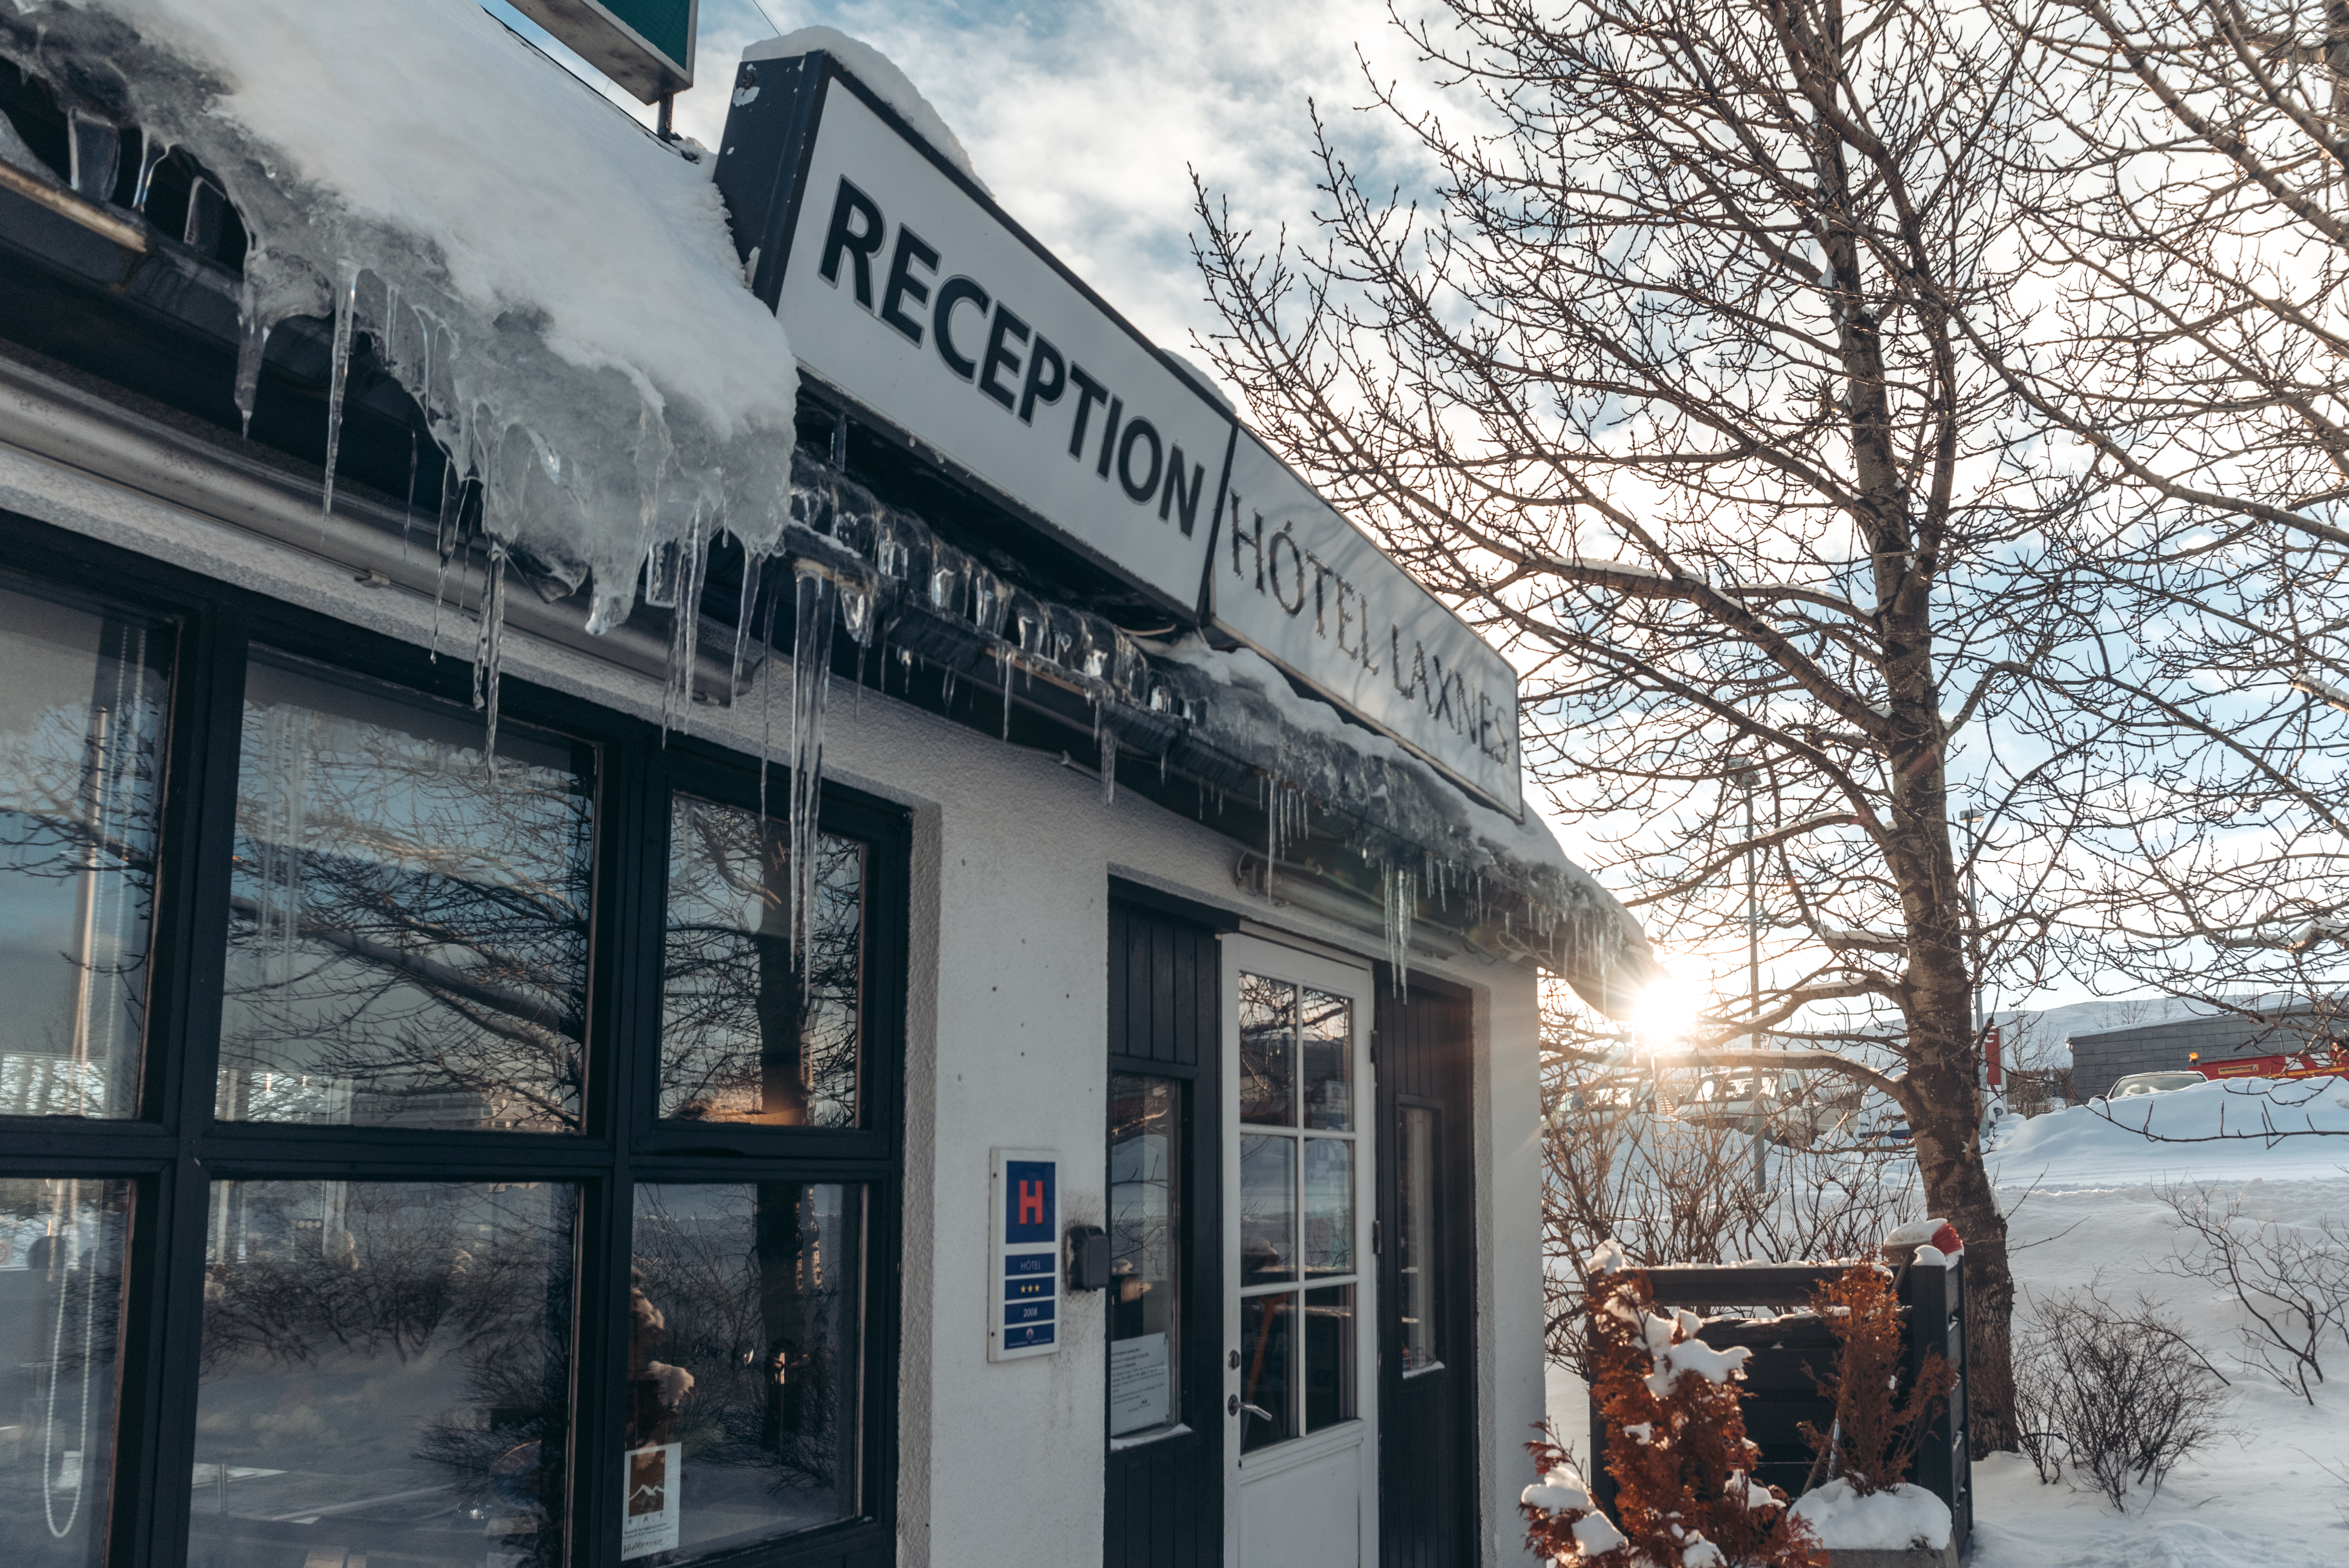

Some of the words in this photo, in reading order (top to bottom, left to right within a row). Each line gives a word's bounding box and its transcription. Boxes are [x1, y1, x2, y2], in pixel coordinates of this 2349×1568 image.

[818, 173, 1205, 540] RECEPTION
[1229, 487, 1379, 677] HÓTEL
[1392, 623, 1510, 768] LAXNES
[1020, 1180, 1043, 1225] H
[1020, 1259, 1041, 1271] HÓTEL
